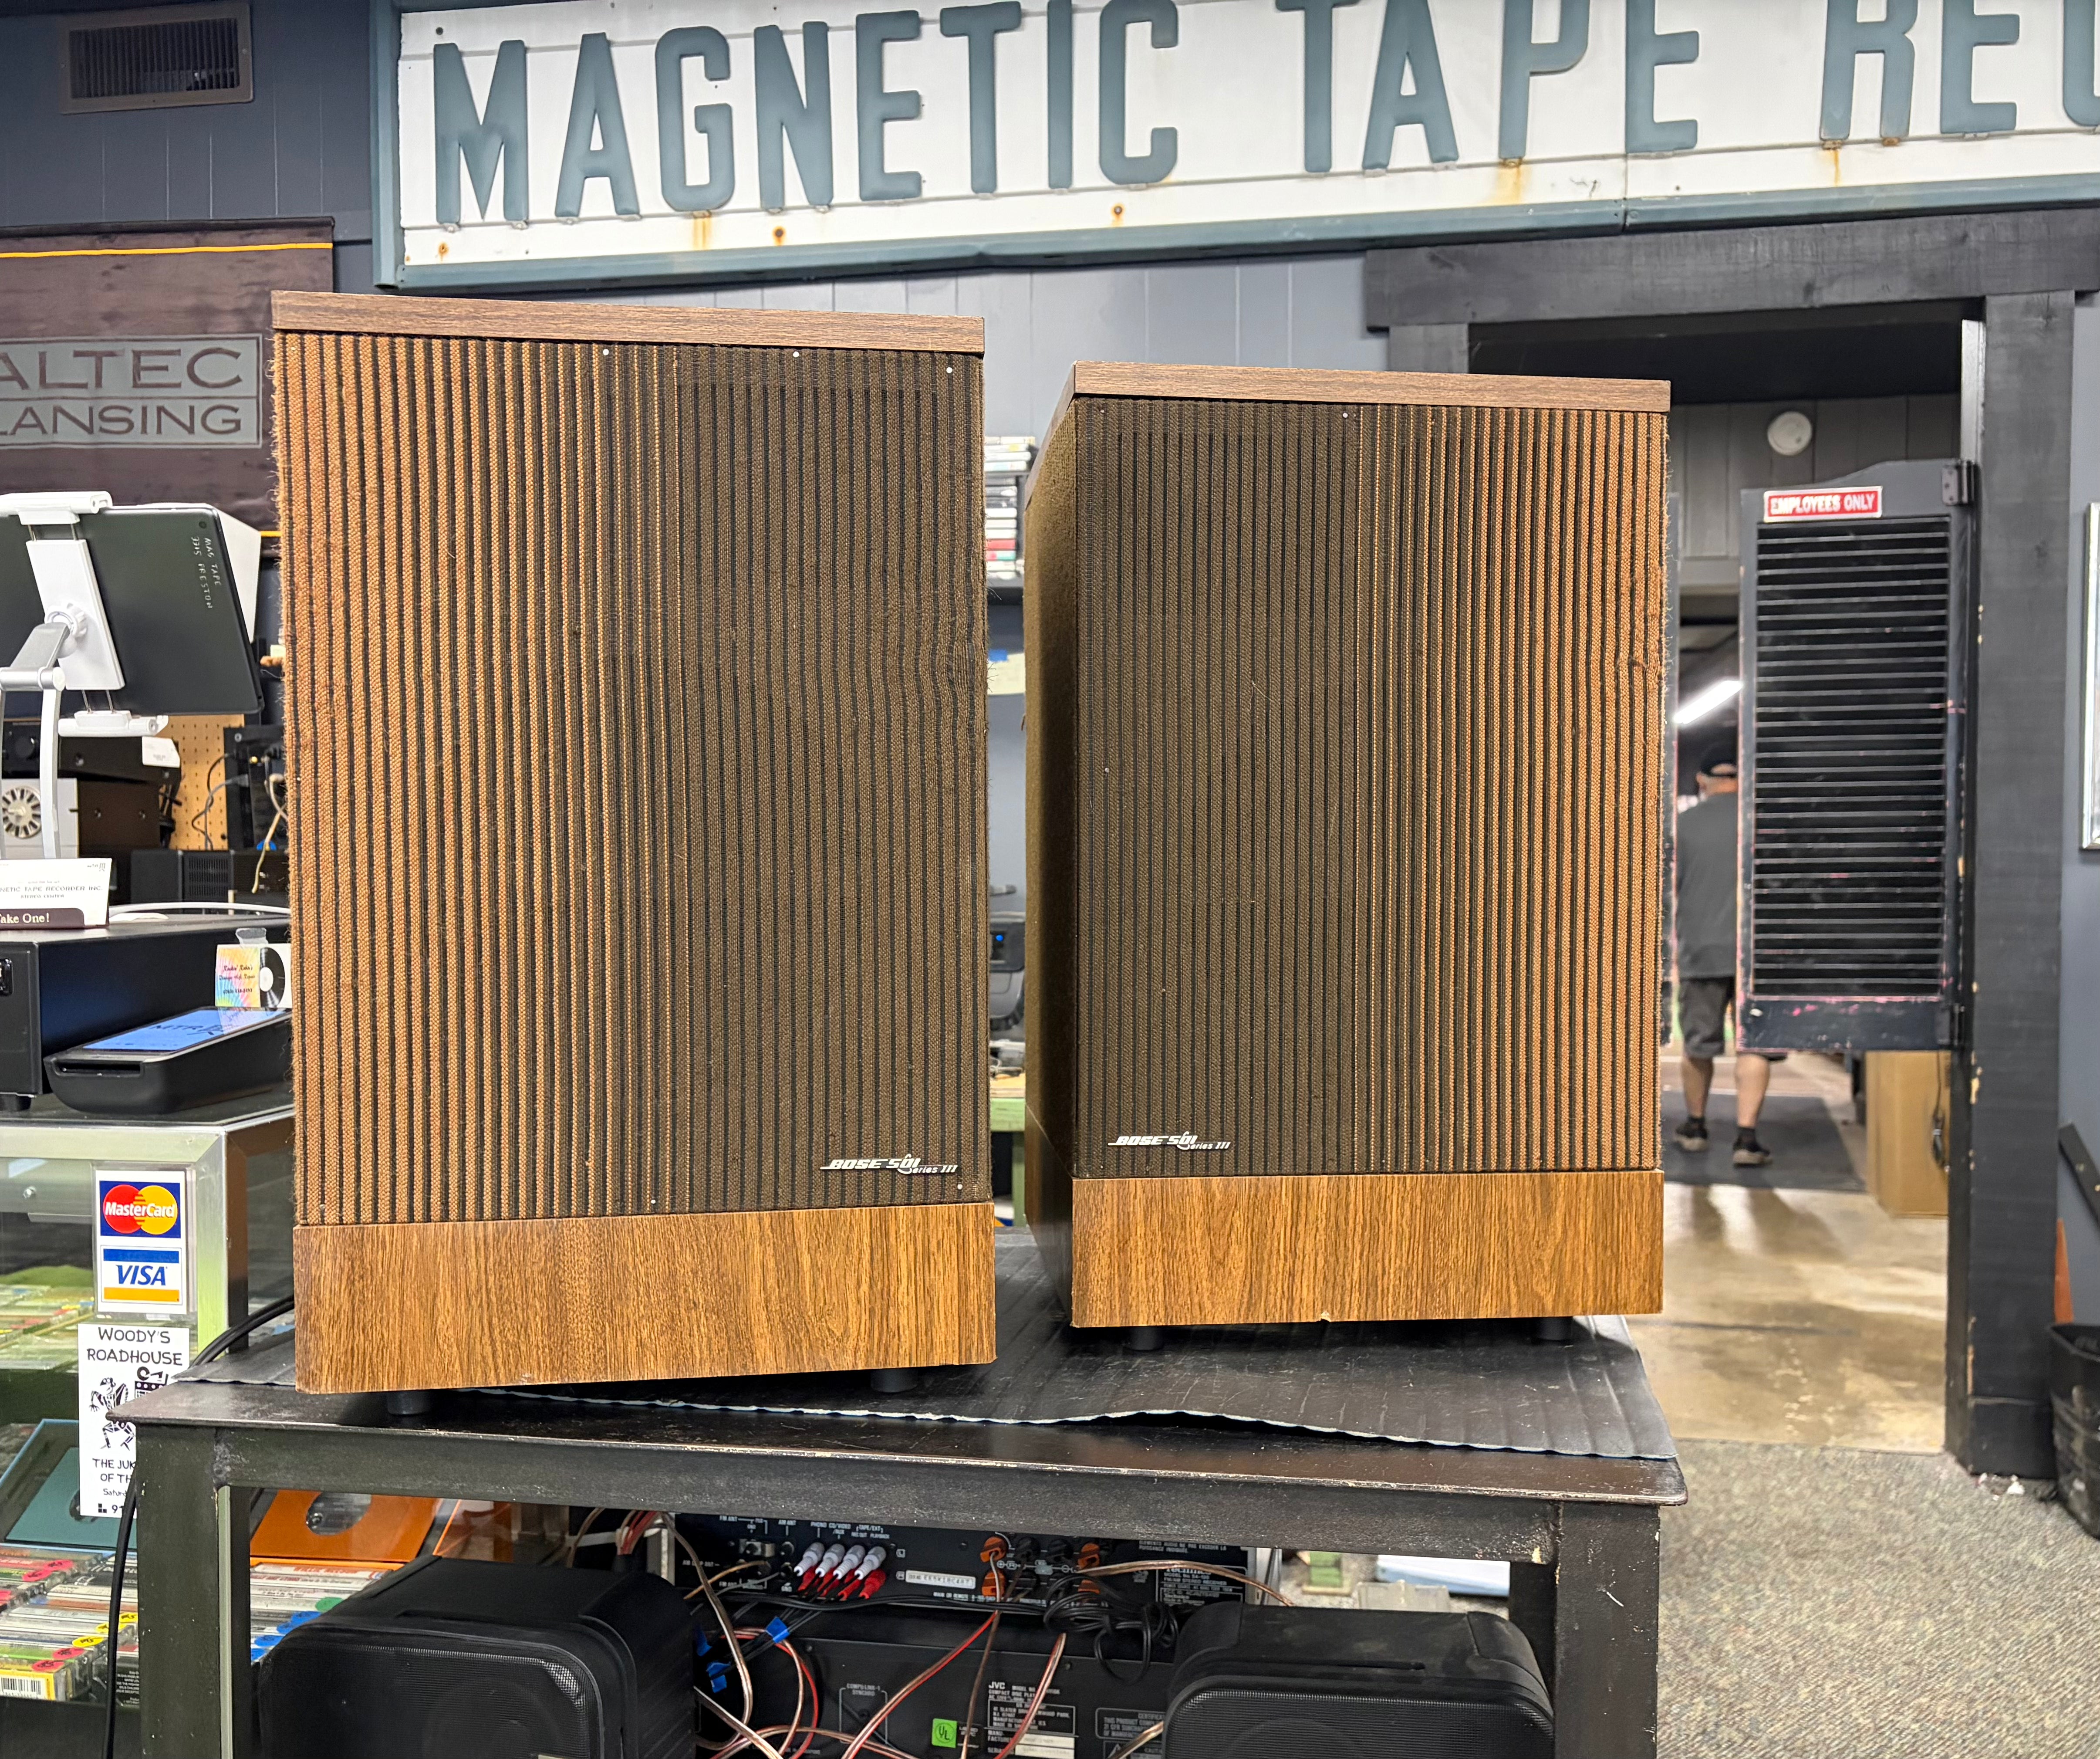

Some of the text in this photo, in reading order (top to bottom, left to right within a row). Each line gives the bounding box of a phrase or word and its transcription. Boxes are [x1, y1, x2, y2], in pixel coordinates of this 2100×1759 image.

[433, 0, 1178, 223] MAGNETIC
[1274, 0, 1699, 173] TAPE
[0, 405, 242, 436] ANSING
[1770, 493, 1876, 514] EMPLOYEES ONLY
[203, 538, 221, 586] MAG TAPE
[23, 913, 49, 923] One!
[1107, 1135, 1198, 1146] BOSE 501
[820, 1157, 921, 1170] BOSE 501
[941, 1165, 958, 1173] III
[105, 1201, 176, 1218] MasterCard
[115, 1264, 166, 1286] VISA
[98, 1327, 171, 1344] WOODY'S
[87, 1348, 183, 1366] ROADHOUSE
[92, 1458, 115, 1469] THE
[100, 1473, 114, 1482] OF
